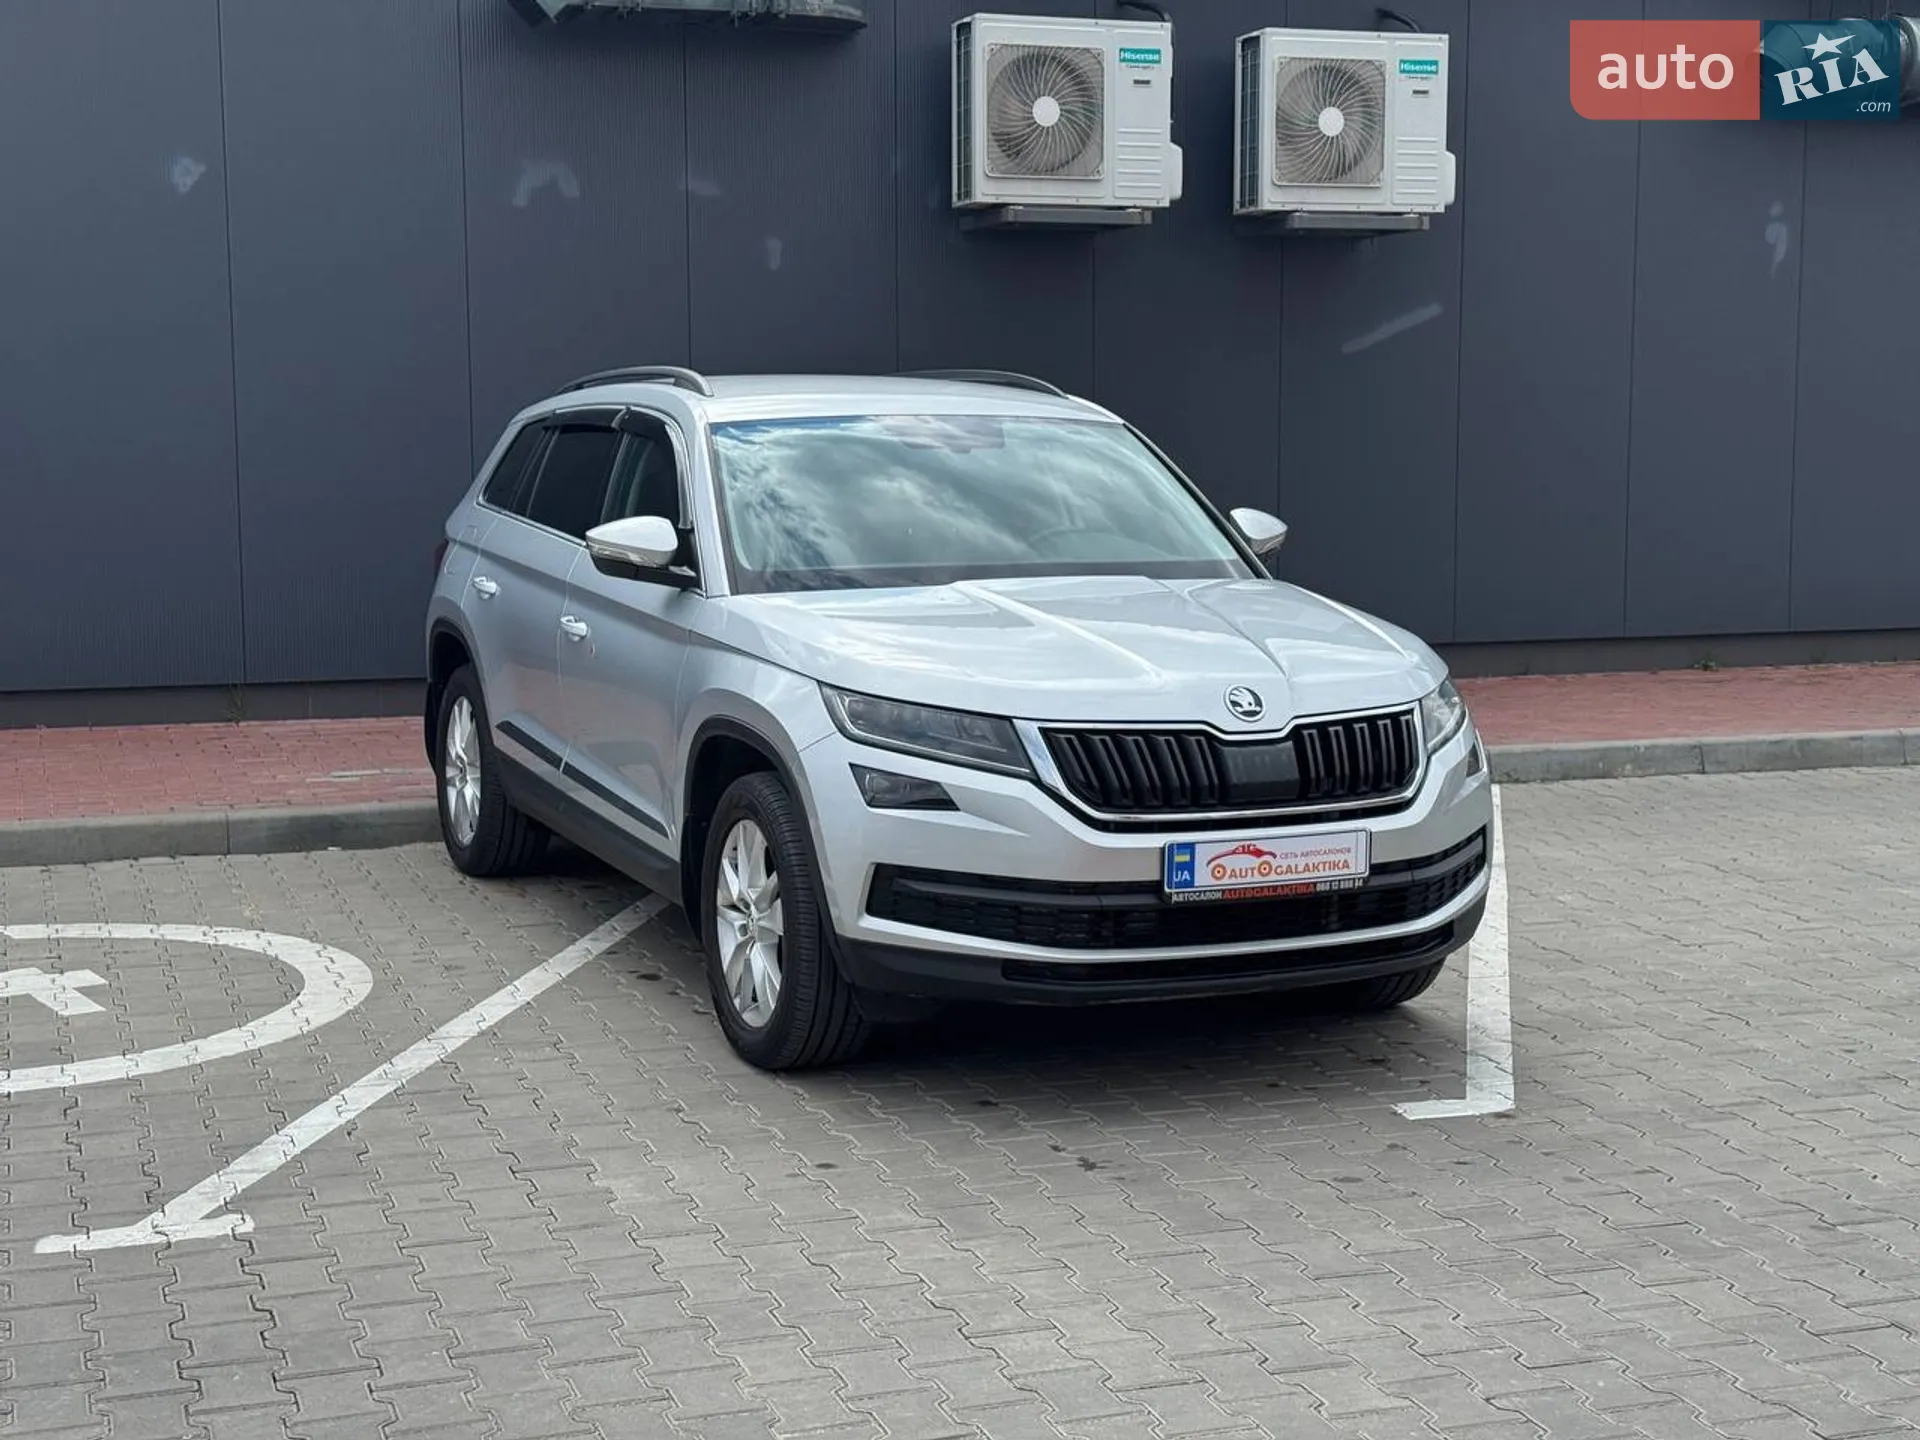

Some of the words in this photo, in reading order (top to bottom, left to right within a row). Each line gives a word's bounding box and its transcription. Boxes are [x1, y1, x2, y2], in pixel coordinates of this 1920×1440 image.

[1120, 50, 1160, 61] Hisense
[1400, 61, 1437, 72] Hisense
[1173, 870, 1191, 882] UA
